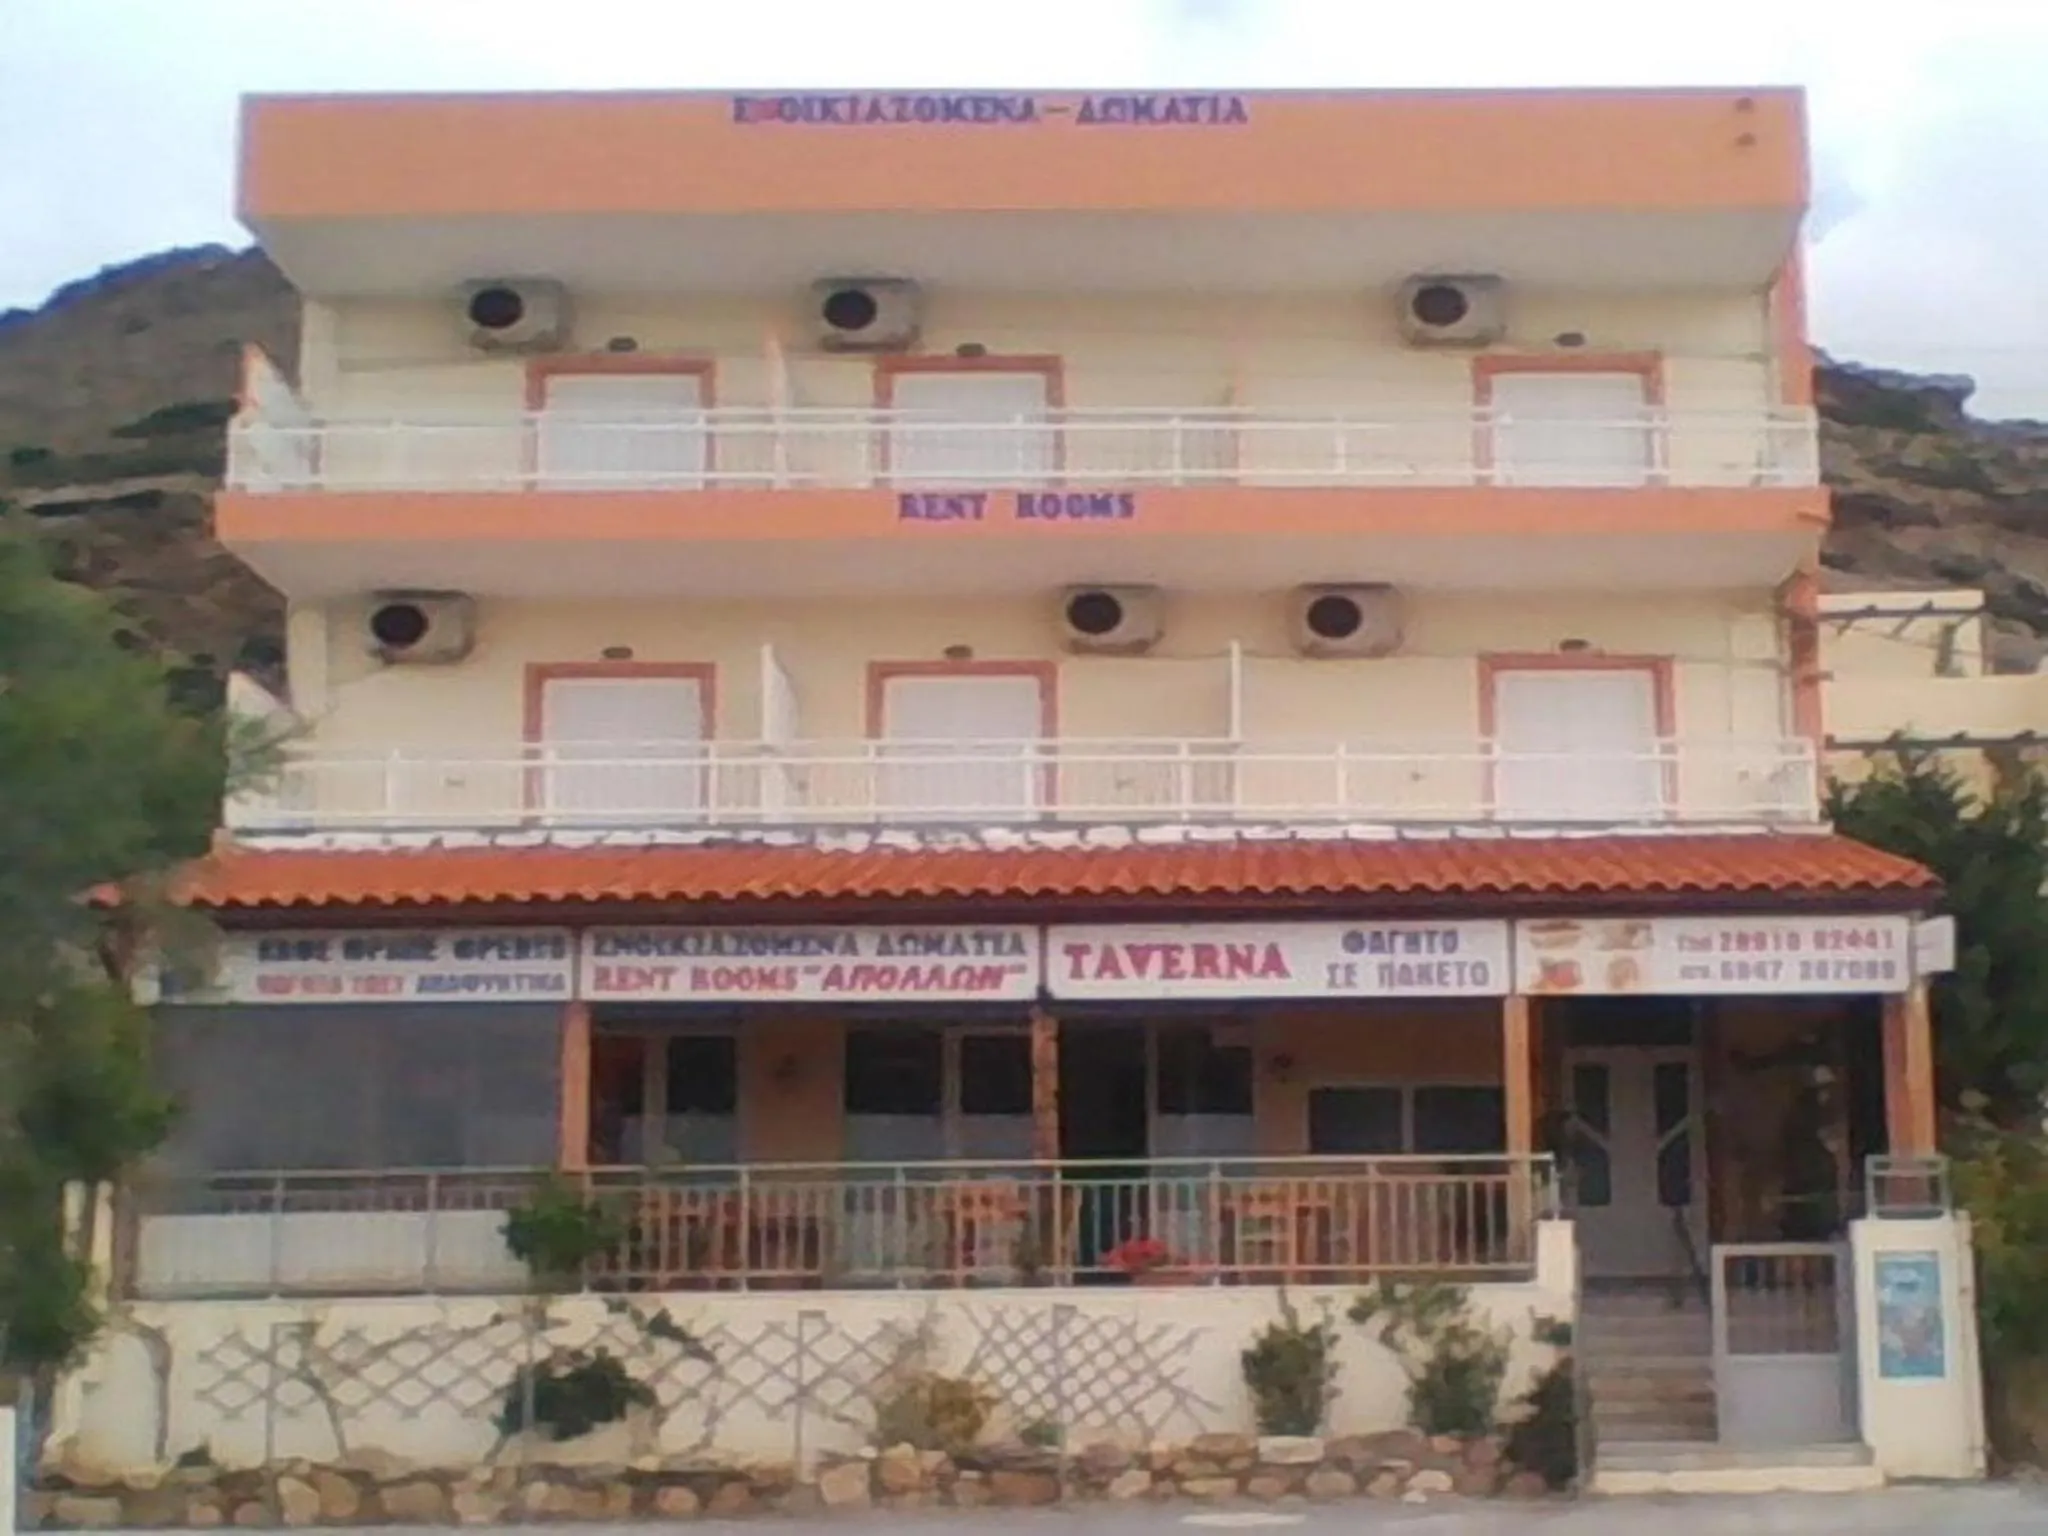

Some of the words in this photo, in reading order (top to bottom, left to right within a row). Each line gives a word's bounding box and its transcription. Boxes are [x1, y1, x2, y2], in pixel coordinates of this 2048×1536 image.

[899, 493, 986, 519] RENT
[1016, 493, 1134, 519] ROOMS
[1342, 930, 1458, 953] ΦΑΓΗΤΟ
[1063, 942, 1291, 979] TAVERNA
[594, 965, 678, 991] RENT
[691, 965, 799, 991] ROOMS
[1327, 963, 1357, 988] ΣΕ
[1378, 961, 1489, 988] ΠΑΚΕΤΟ
